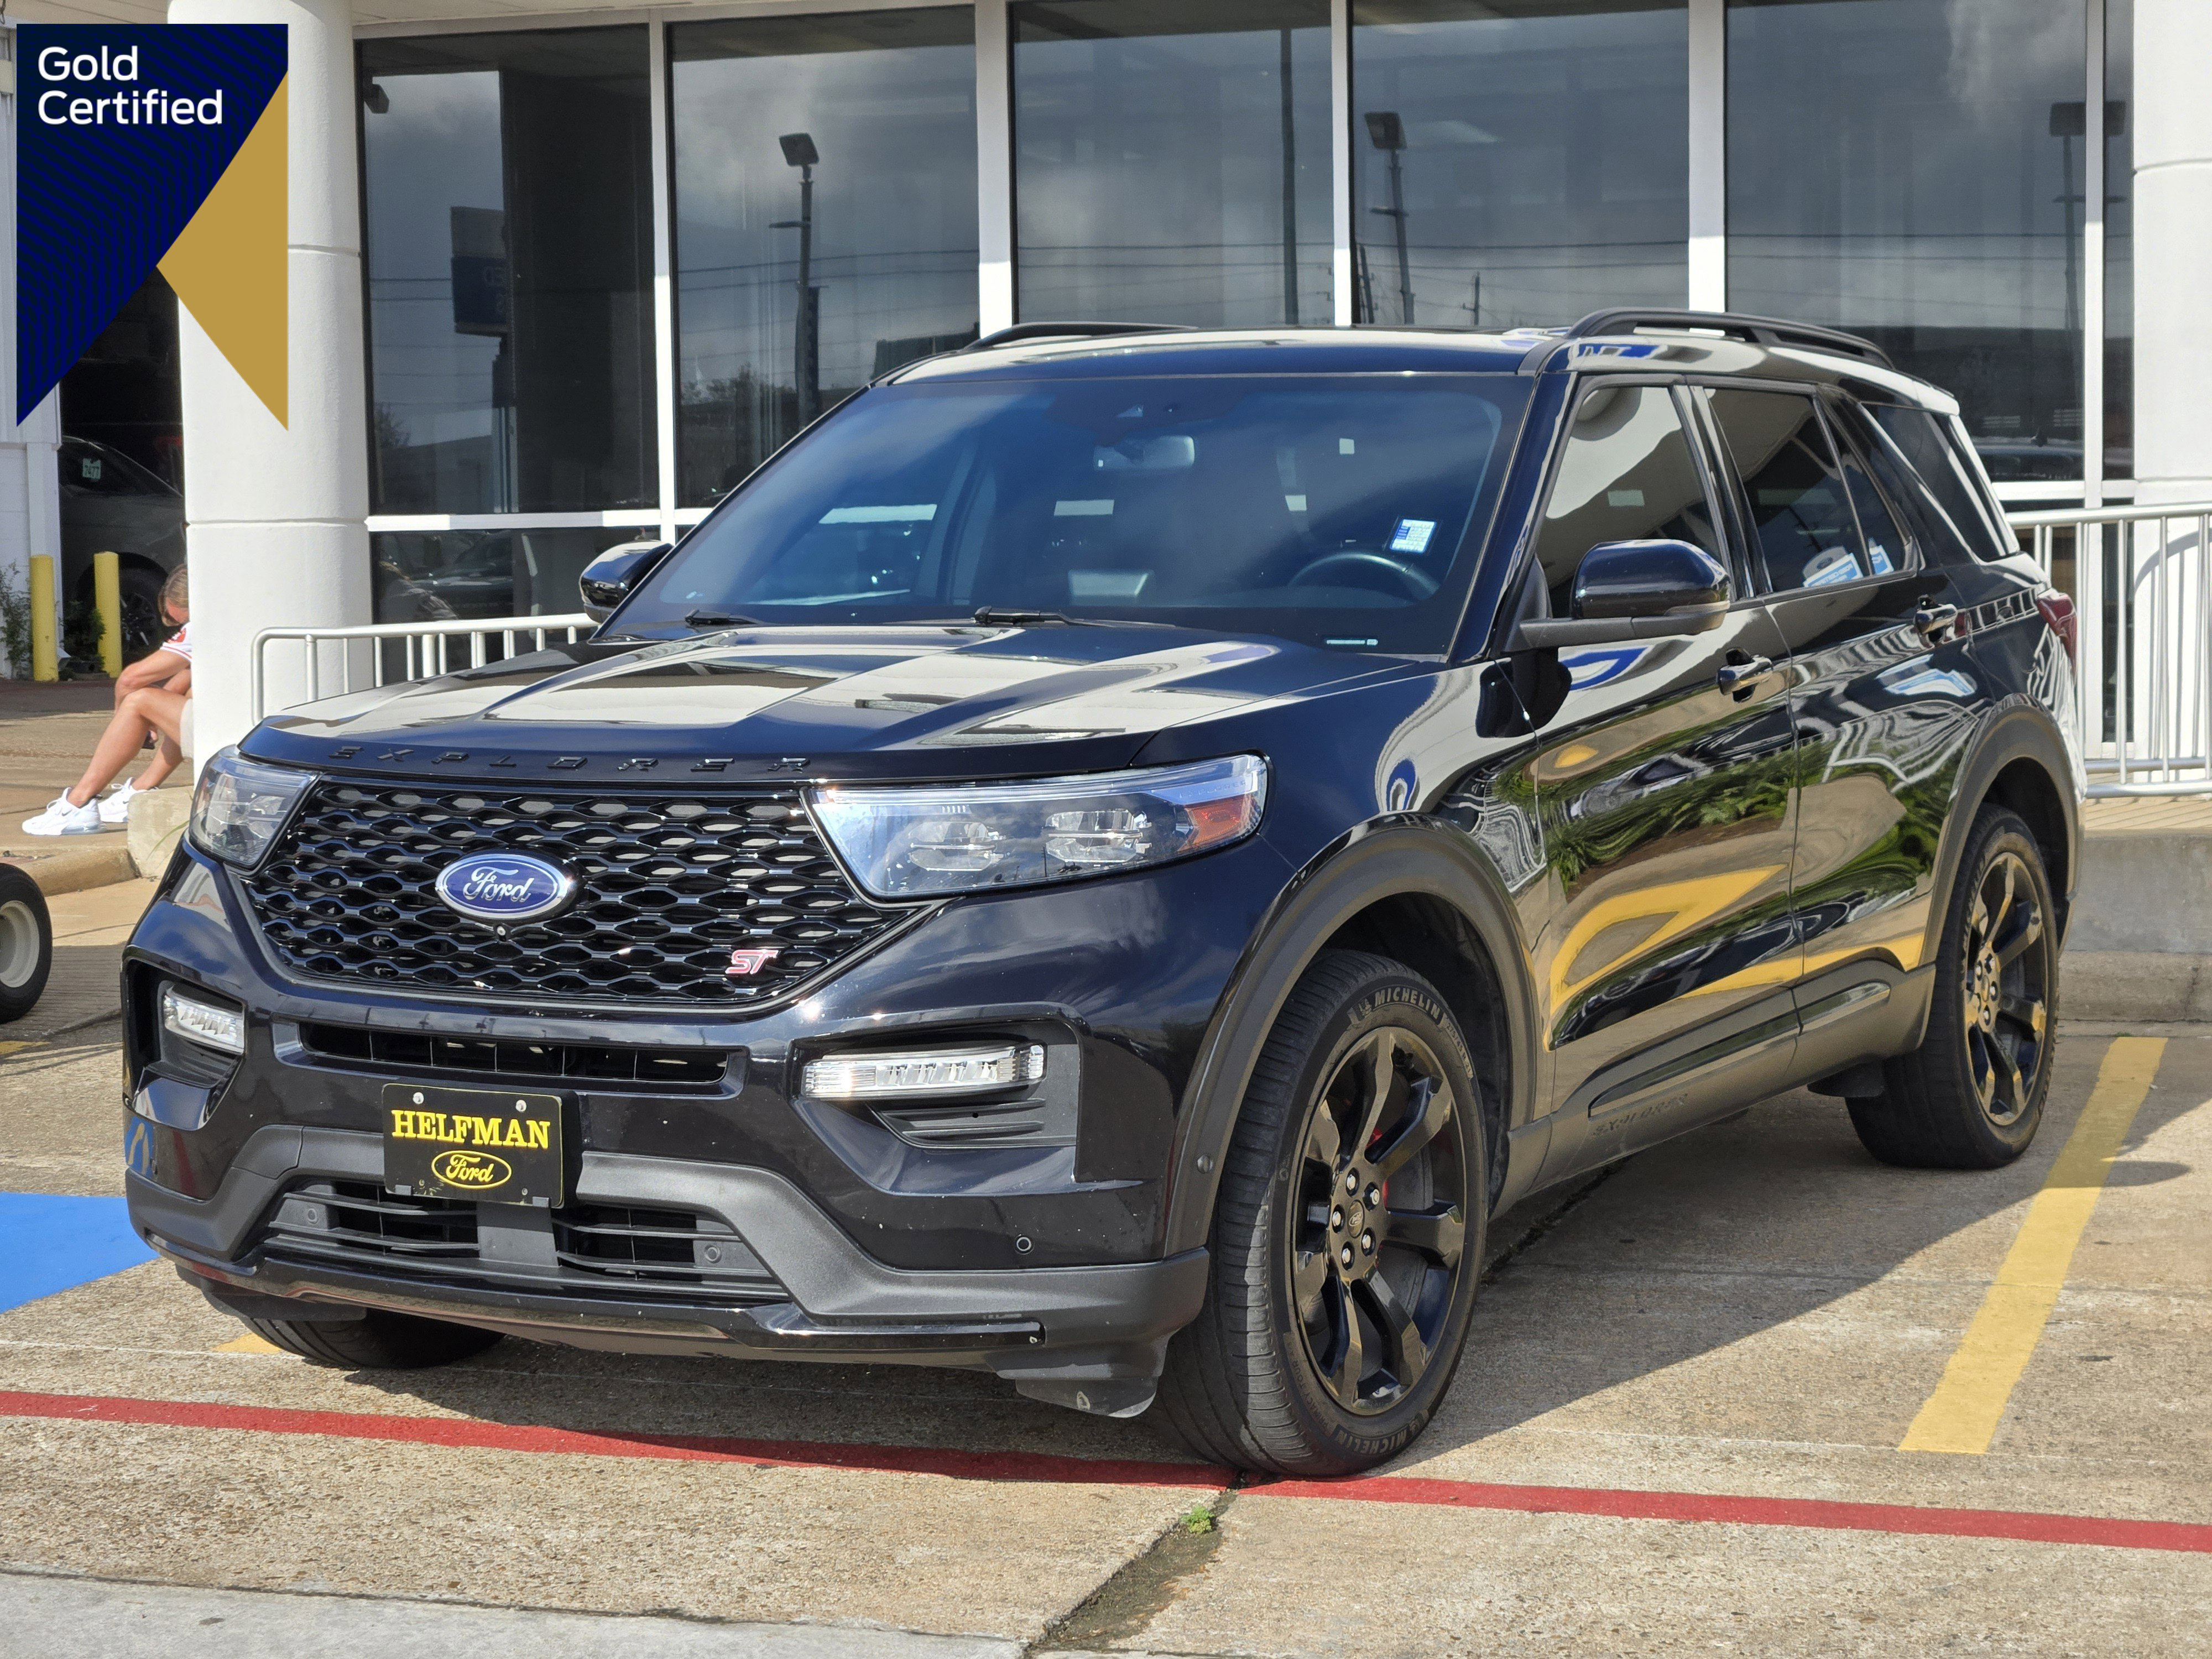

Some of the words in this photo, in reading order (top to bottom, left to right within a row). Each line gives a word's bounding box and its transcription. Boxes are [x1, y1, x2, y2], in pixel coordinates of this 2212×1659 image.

[328, 745, 811, 773] EXPLORER
[463, 866, 535, 902] Ford
[725, 949, 779, 974] ST
[1374, 987, 1441, 1020] MICHELIN
[391, 1109, 551, 1149] HELFMAN
[446, 1154, 494, 1182] Ford
[1291, 1359, 1306, 1389] TOUR
[1335, 1428, 1407, 1454] MICHELIN
